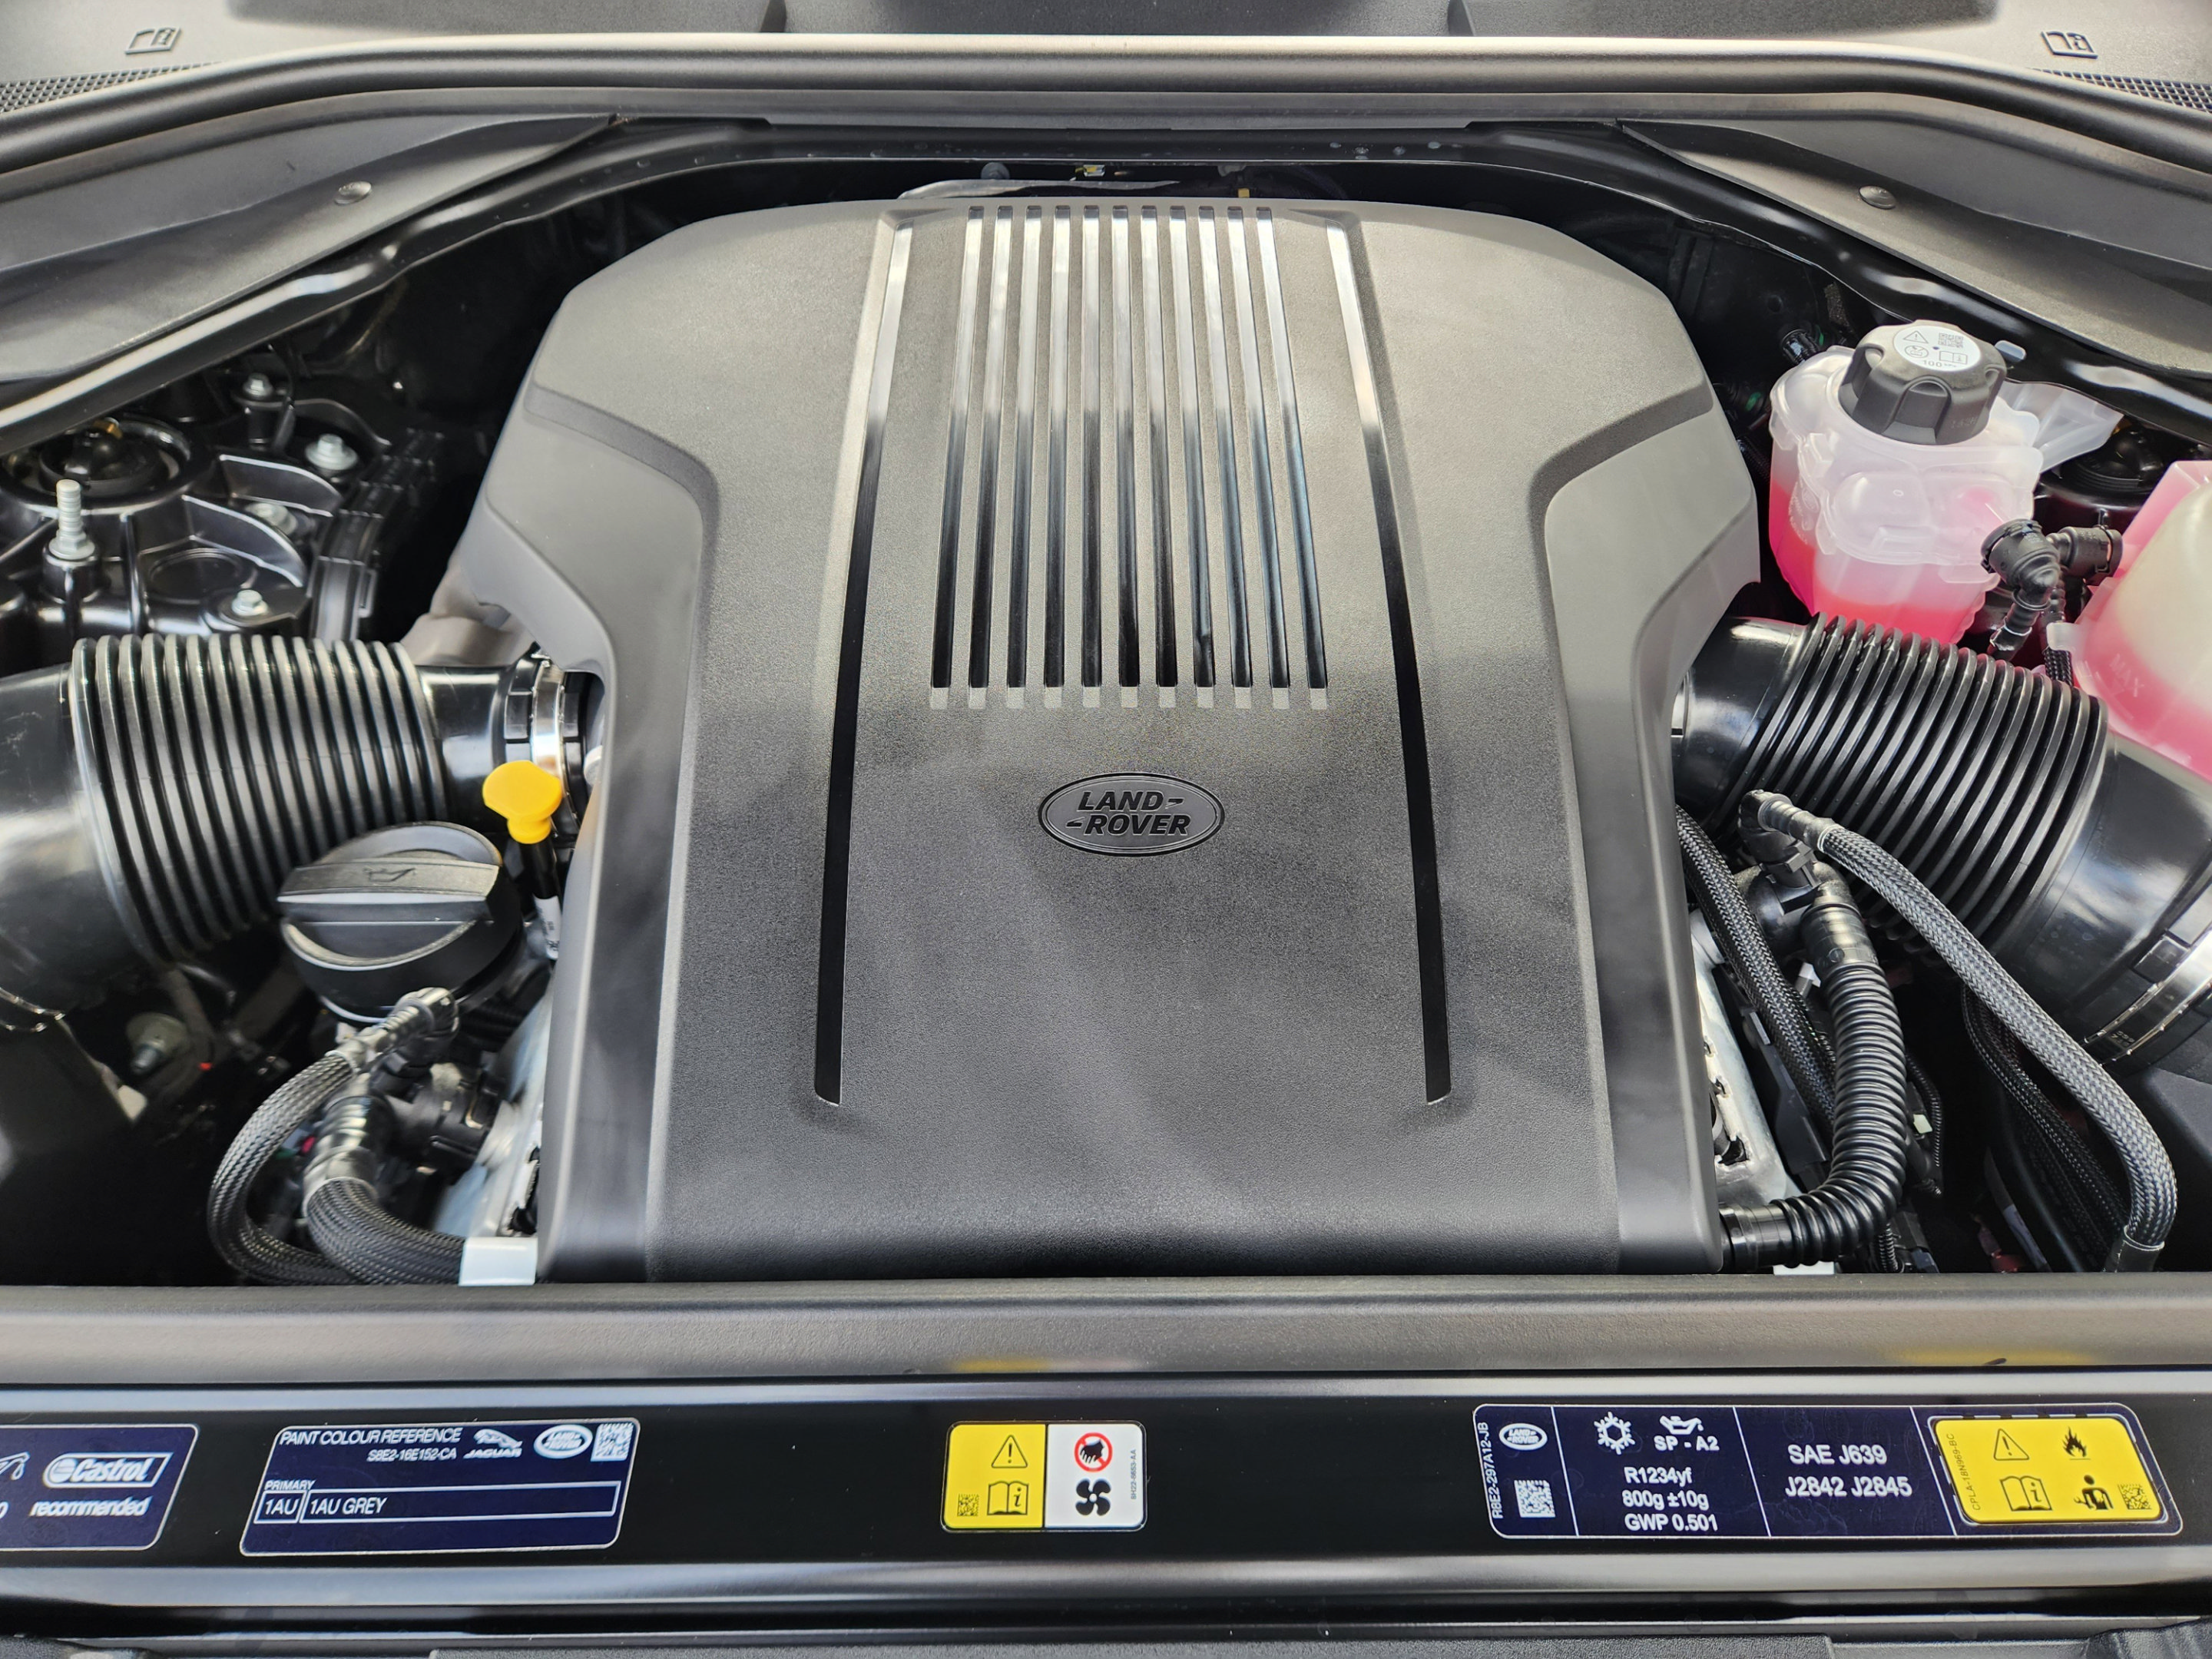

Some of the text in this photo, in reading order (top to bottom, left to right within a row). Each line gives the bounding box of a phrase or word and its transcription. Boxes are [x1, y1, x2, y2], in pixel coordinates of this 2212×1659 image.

[2108, 653, 2145, 697] MAX
[1077, 791, 1164, 812] LAND
[1084, 813, 1191, 836] ROVER
[279, 1427, 462, 1445] PAINT COLOUR REFERENCE
[1654, 1437, 1677, 1451] SP
[1696, 1436, 1720, 1452] A2
[463, 1448, 523, 1459] JAGUAR
[1789, 1445, 1887, 1465] SAE J639
[72, 1458, 156, 1483] Castrol
[1477, 1422, 1504, 1518] R8E2-297A12-JB
[1624, 1467, 1693, 1486] R1234yf
[264, 1479, 316, 1491] PRIMARY
[1784, 1477, 1912, 1497] J2842 J2845
[29, 1495, 154, 1517] recommended
[264, 1498, 298, 1515] 1AU
[310, 1497, 386, 1515] 1AU GREY
[1623, 1491, 1708, 1511] 800g ±10g
[1624, 1514, 1718, 1532] GWP 0.501
